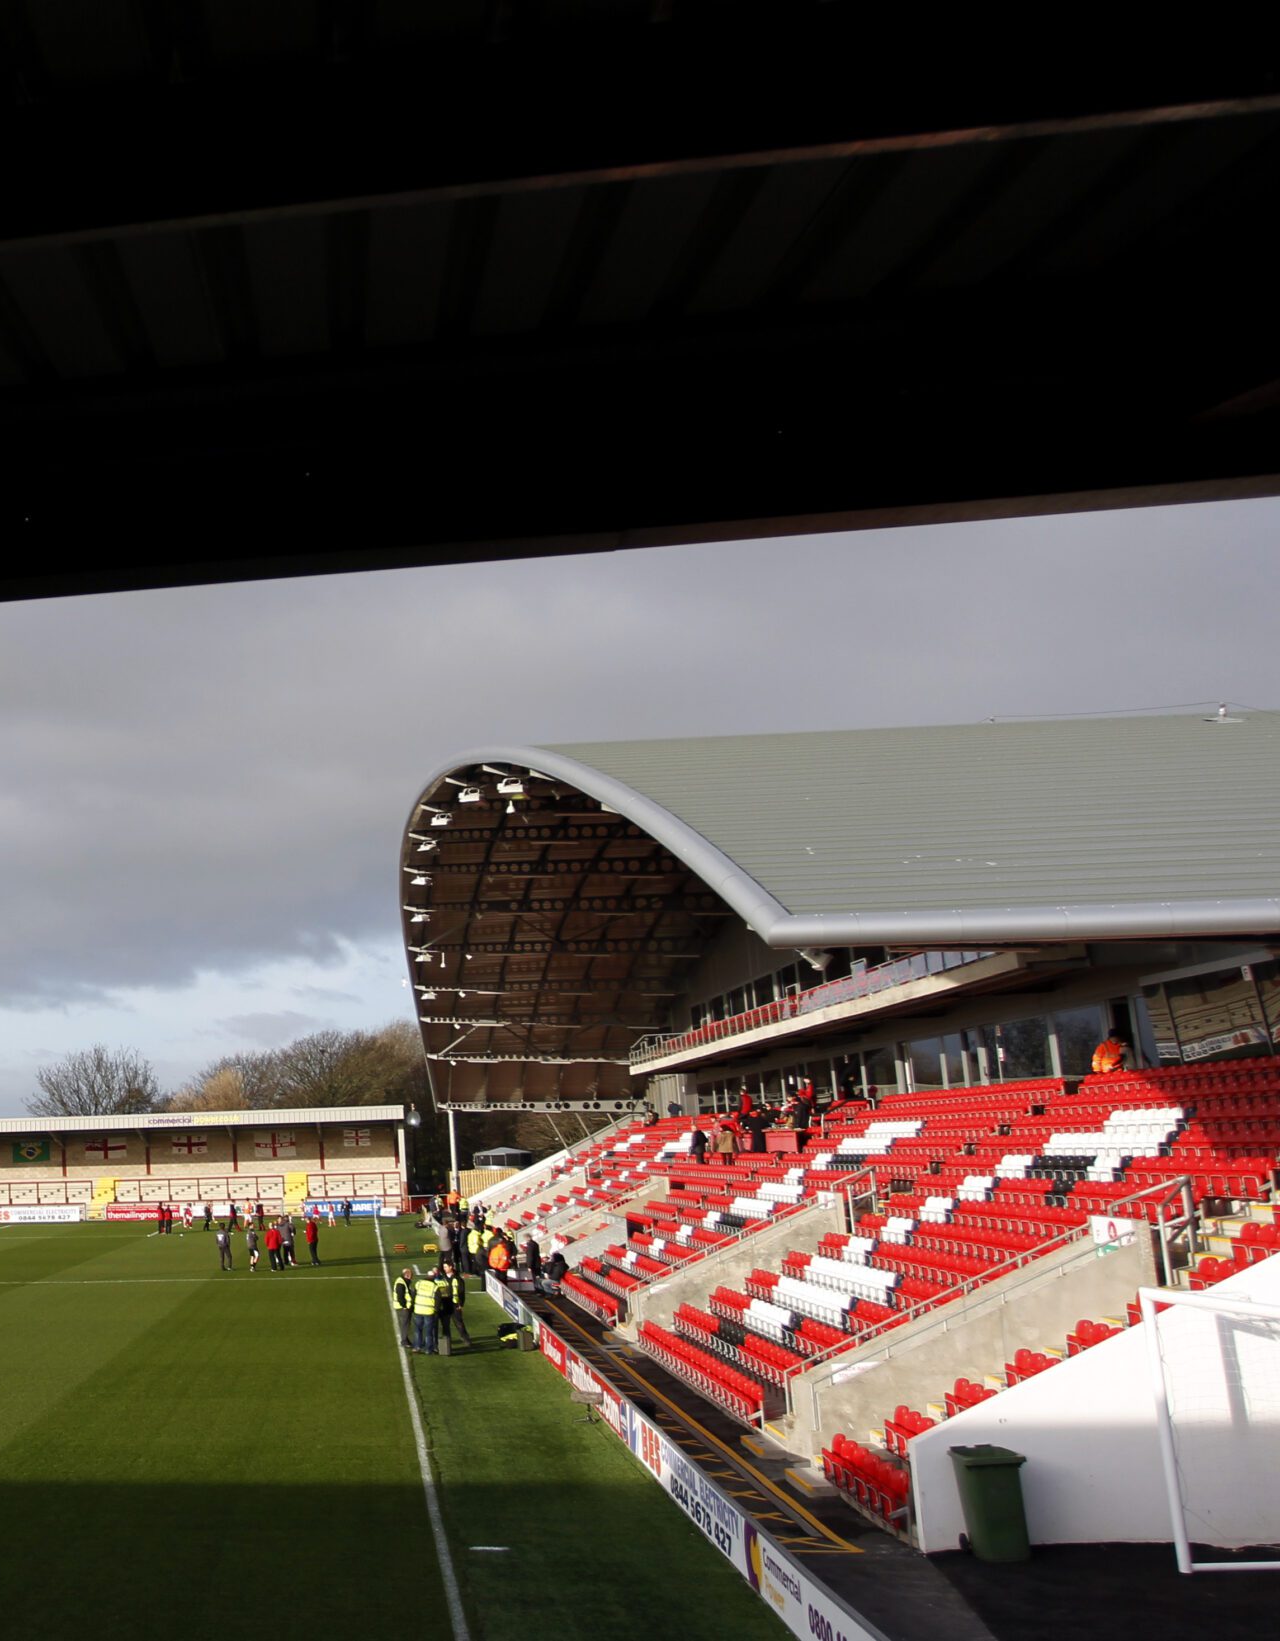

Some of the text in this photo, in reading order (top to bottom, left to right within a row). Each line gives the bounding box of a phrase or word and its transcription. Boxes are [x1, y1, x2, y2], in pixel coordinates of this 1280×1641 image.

[641, 1418, 662, 1477] BES
[661, 1439, 739, 1540] COMMERCIAL ELECTRICITY
[670, 1473, 732, 1557] 0844 5678 427
[763, 1547, 802, 1605] Commercial
[764, 1574, 785, 1612] Power
[808, 1602, 833, 1641] 0800
